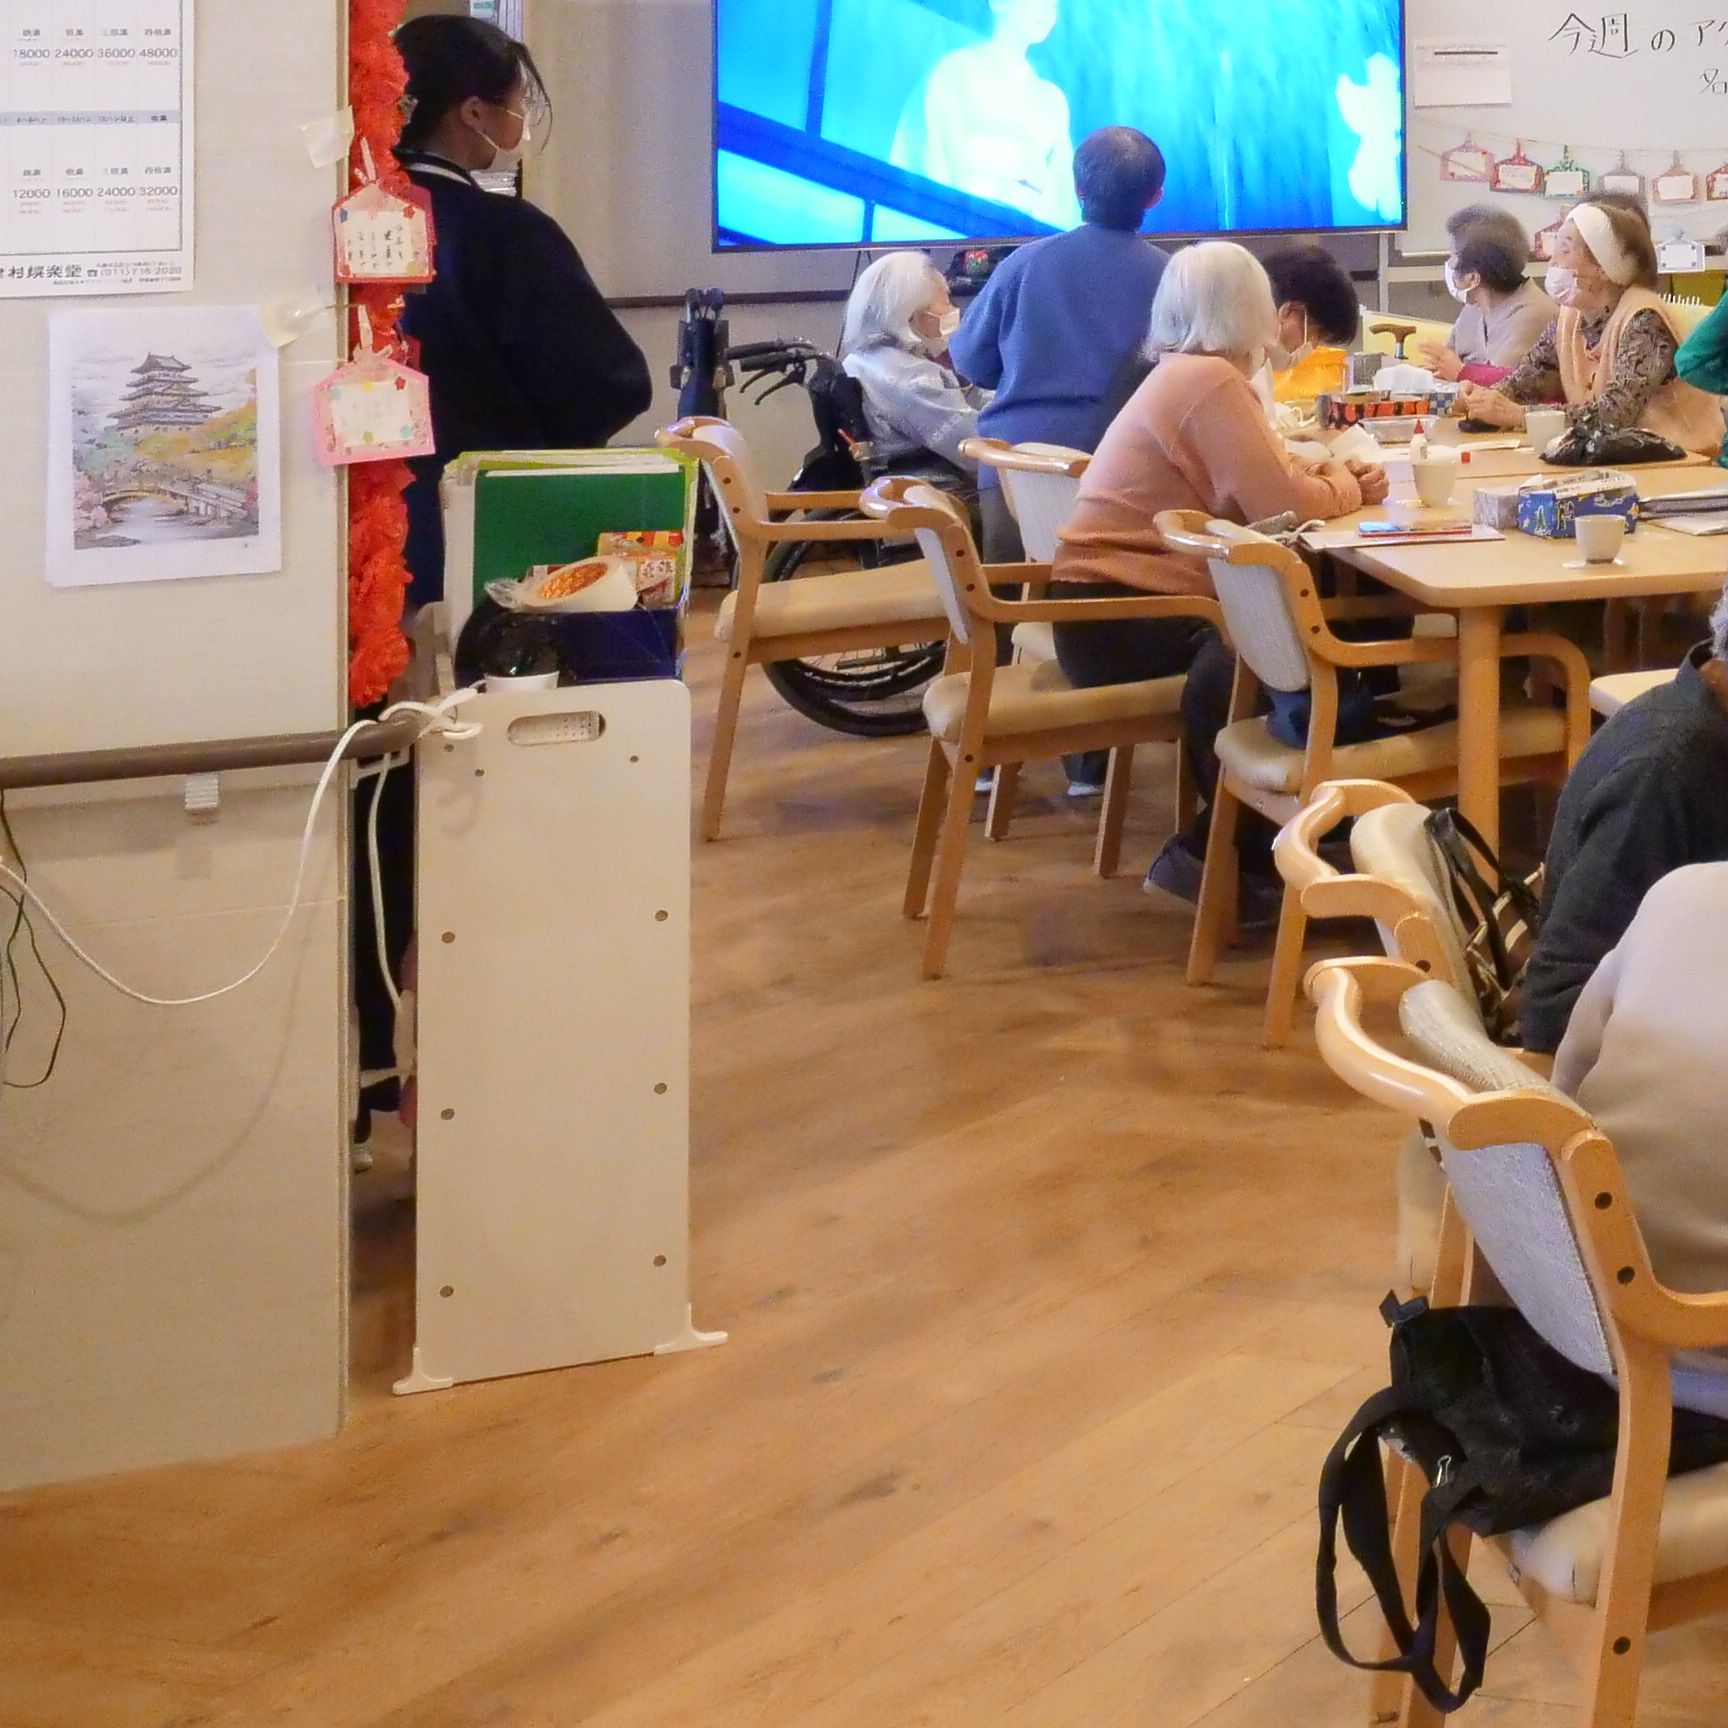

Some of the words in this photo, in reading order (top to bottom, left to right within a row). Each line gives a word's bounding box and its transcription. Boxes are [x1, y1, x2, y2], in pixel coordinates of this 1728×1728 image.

[13, 48, 51, 59] 18000
[54, 48, 94, 59] 24000
[97, 48, 136, 59] 36000
[139, 48, 178, 59] 48000
[13, 188, 51, 199] 12000
[56, 187, 94, 198] 16000
[97, 187, 136, 197] 24000
[139, 186, 178, 197] 32000
